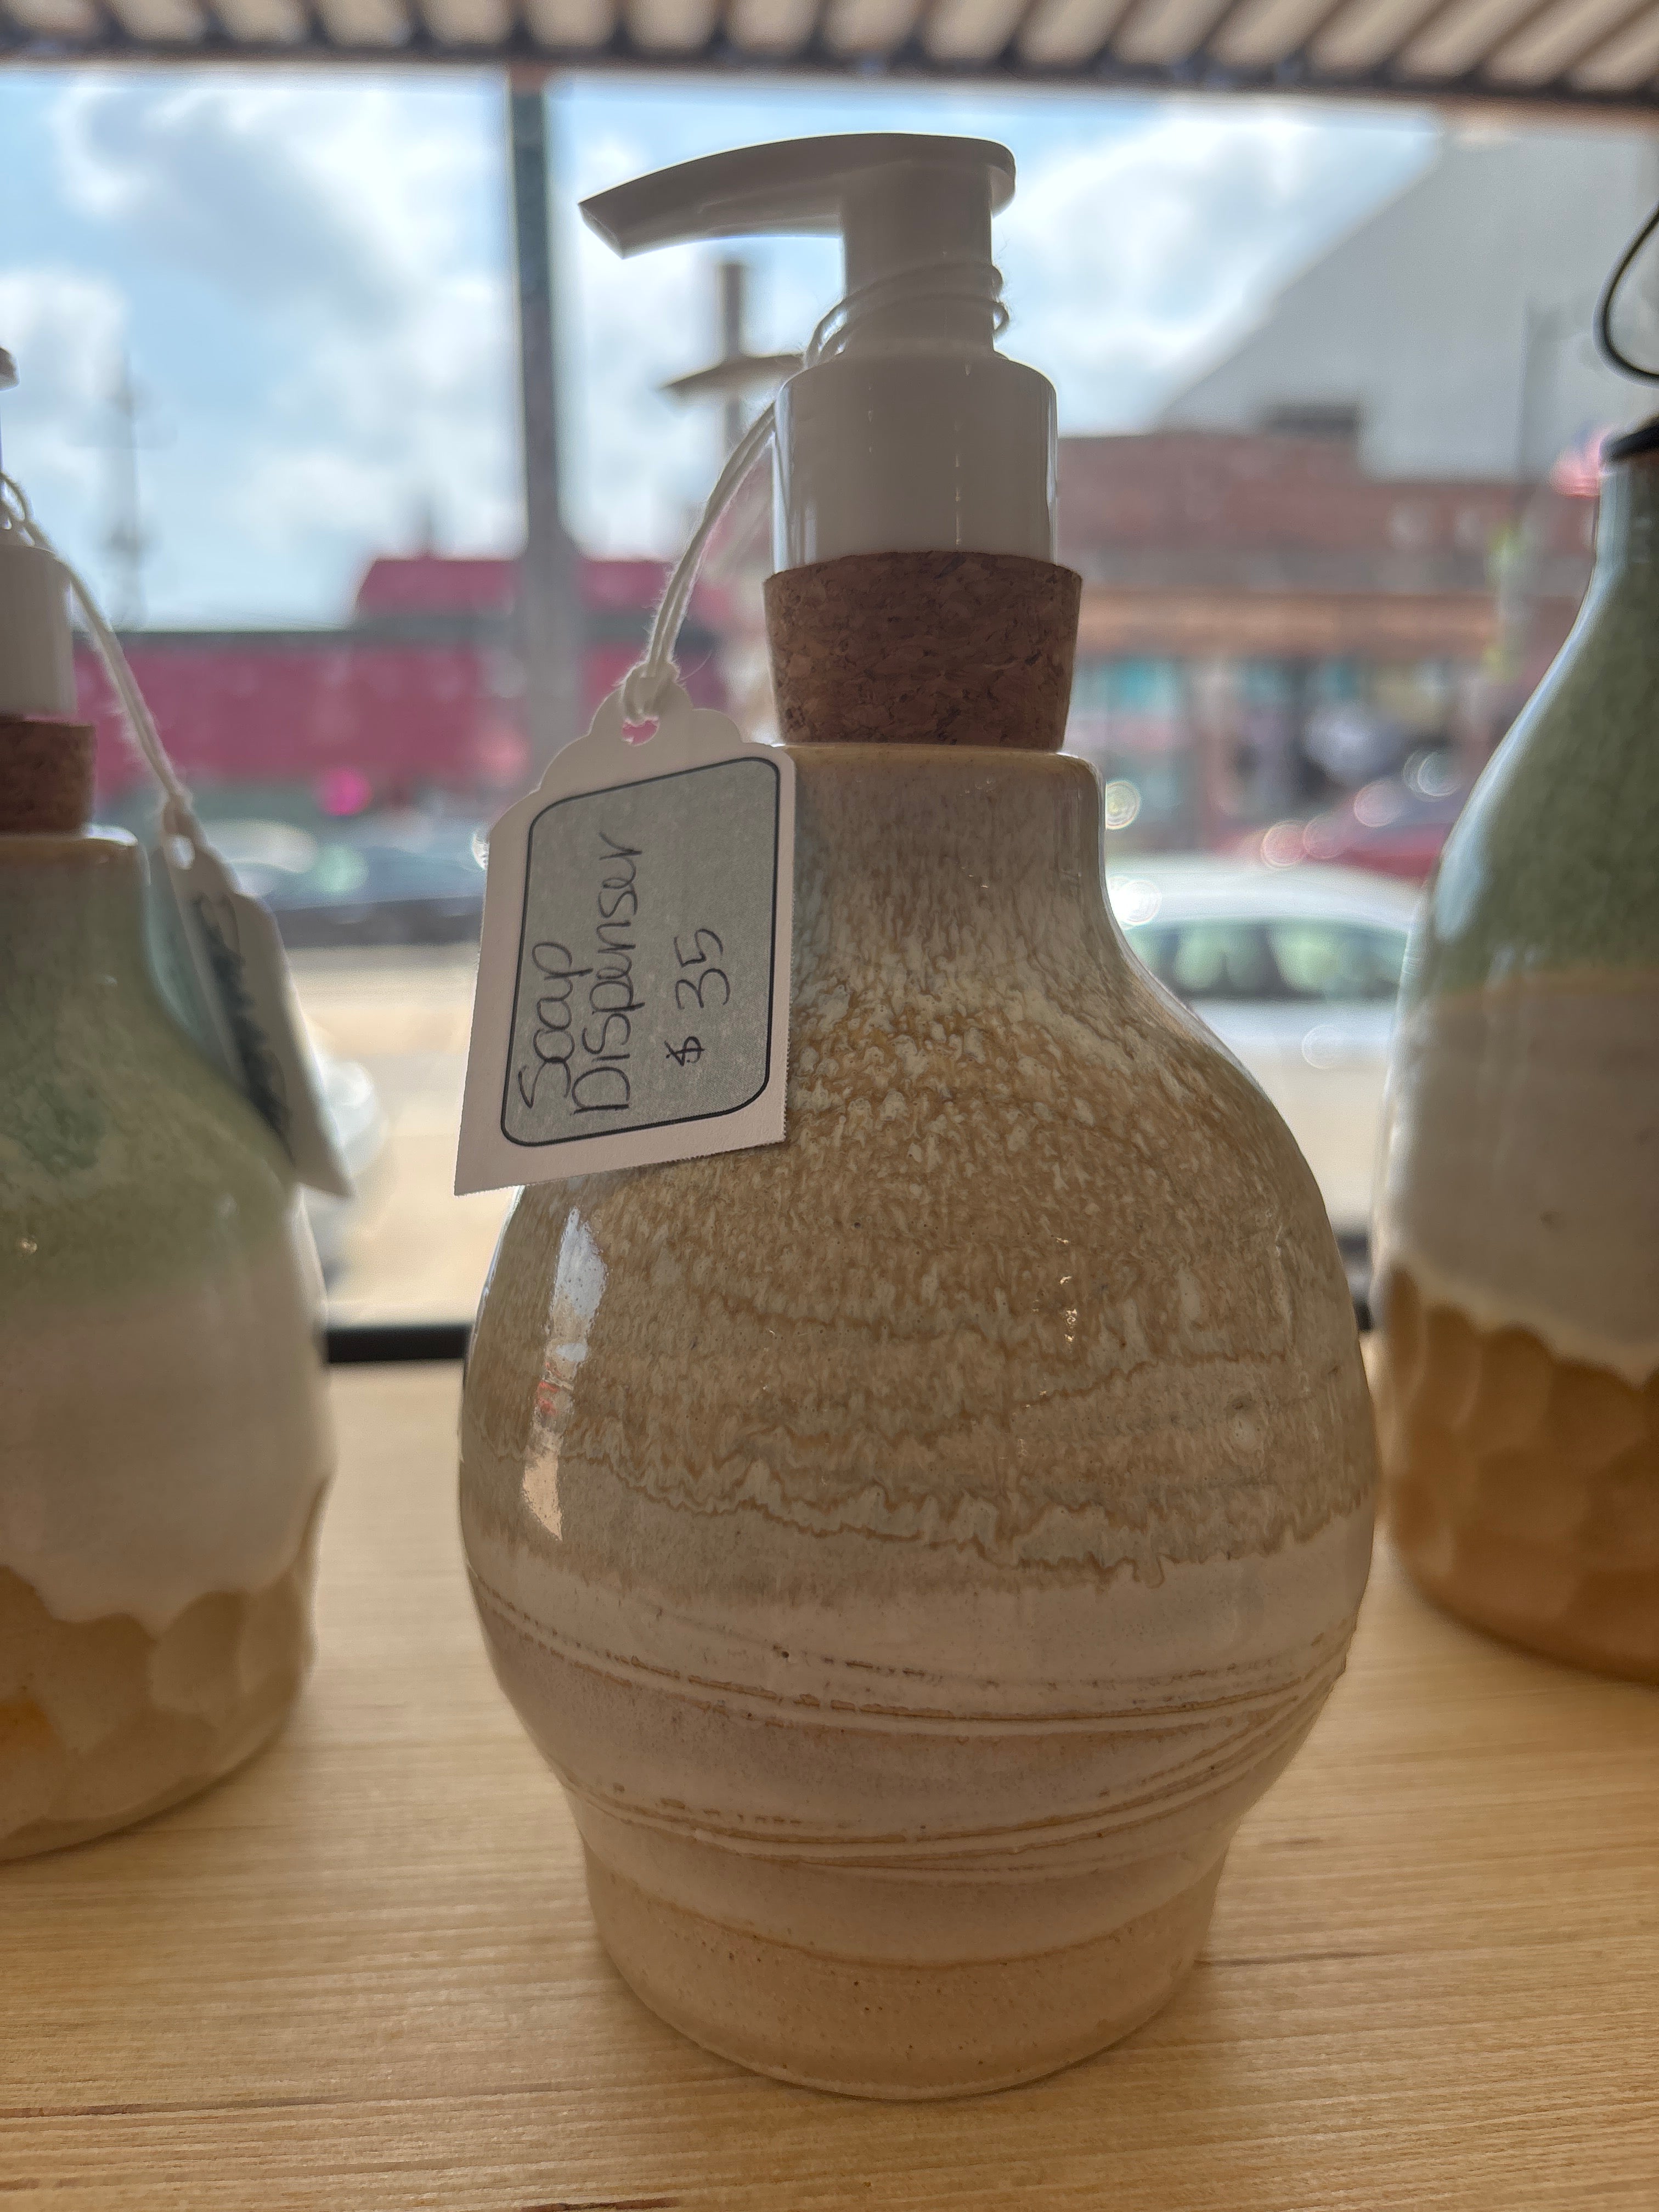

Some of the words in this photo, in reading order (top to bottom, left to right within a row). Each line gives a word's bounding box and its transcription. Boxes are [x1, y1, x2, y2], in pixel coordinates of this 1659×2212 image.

[675, 929, 730, 1011] 35
[519, 943, 593, 1107] Soap
[665, 1036, 704, 1066] $
